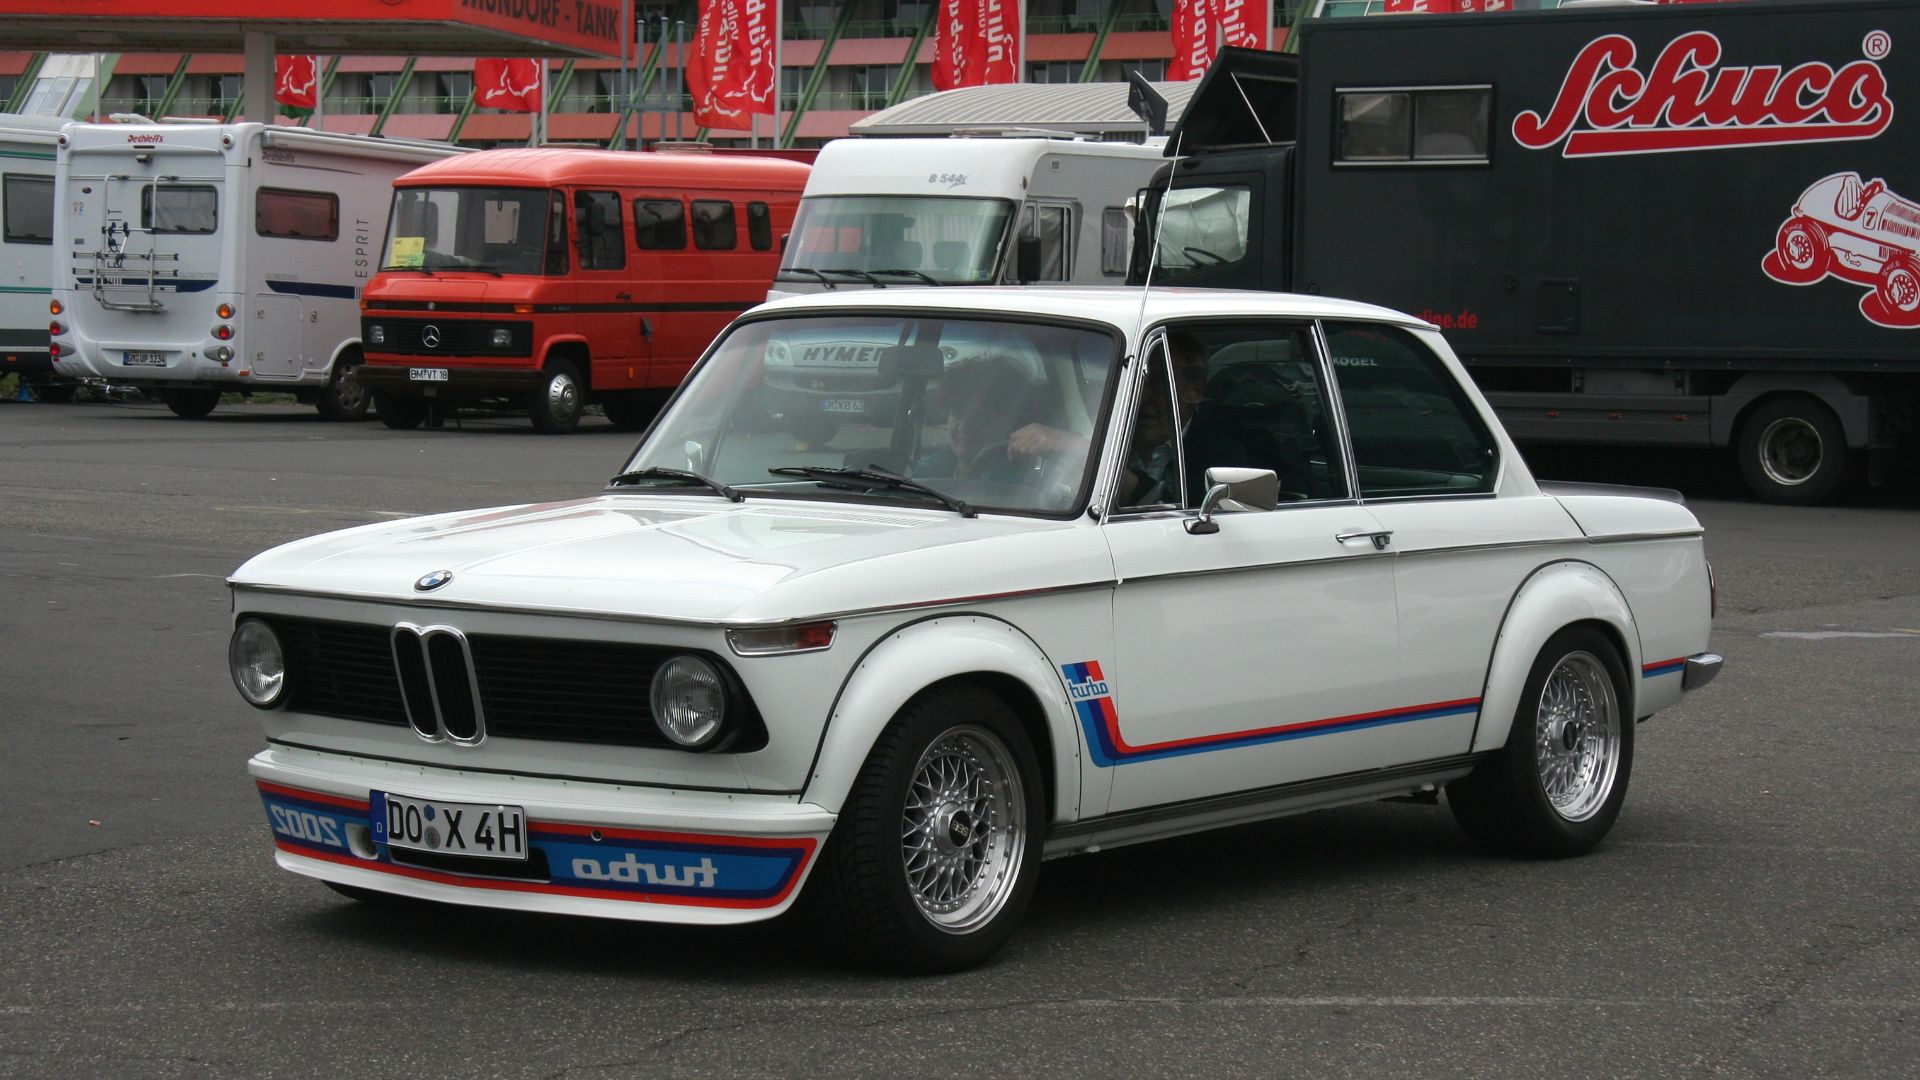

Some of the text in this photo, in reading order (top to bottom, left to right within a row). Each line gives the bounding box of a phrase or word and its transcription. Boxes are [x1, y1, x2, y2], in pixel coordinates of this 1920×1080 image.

[462, 0, 560, 28] NDORF
[576, 1, 619, 41] TANK
[1512, 30, 1893, 157] Schuco
[1866, 211, 1876, 226] 7
[355, 218, 369, 279] ESPRIT
[1415, 309, 1478, 329] line.de
[1067, 678, 1109, 699] turbo
[376, 822, 383, 834] D
[388, 801, 521, 853] DO X 4H
